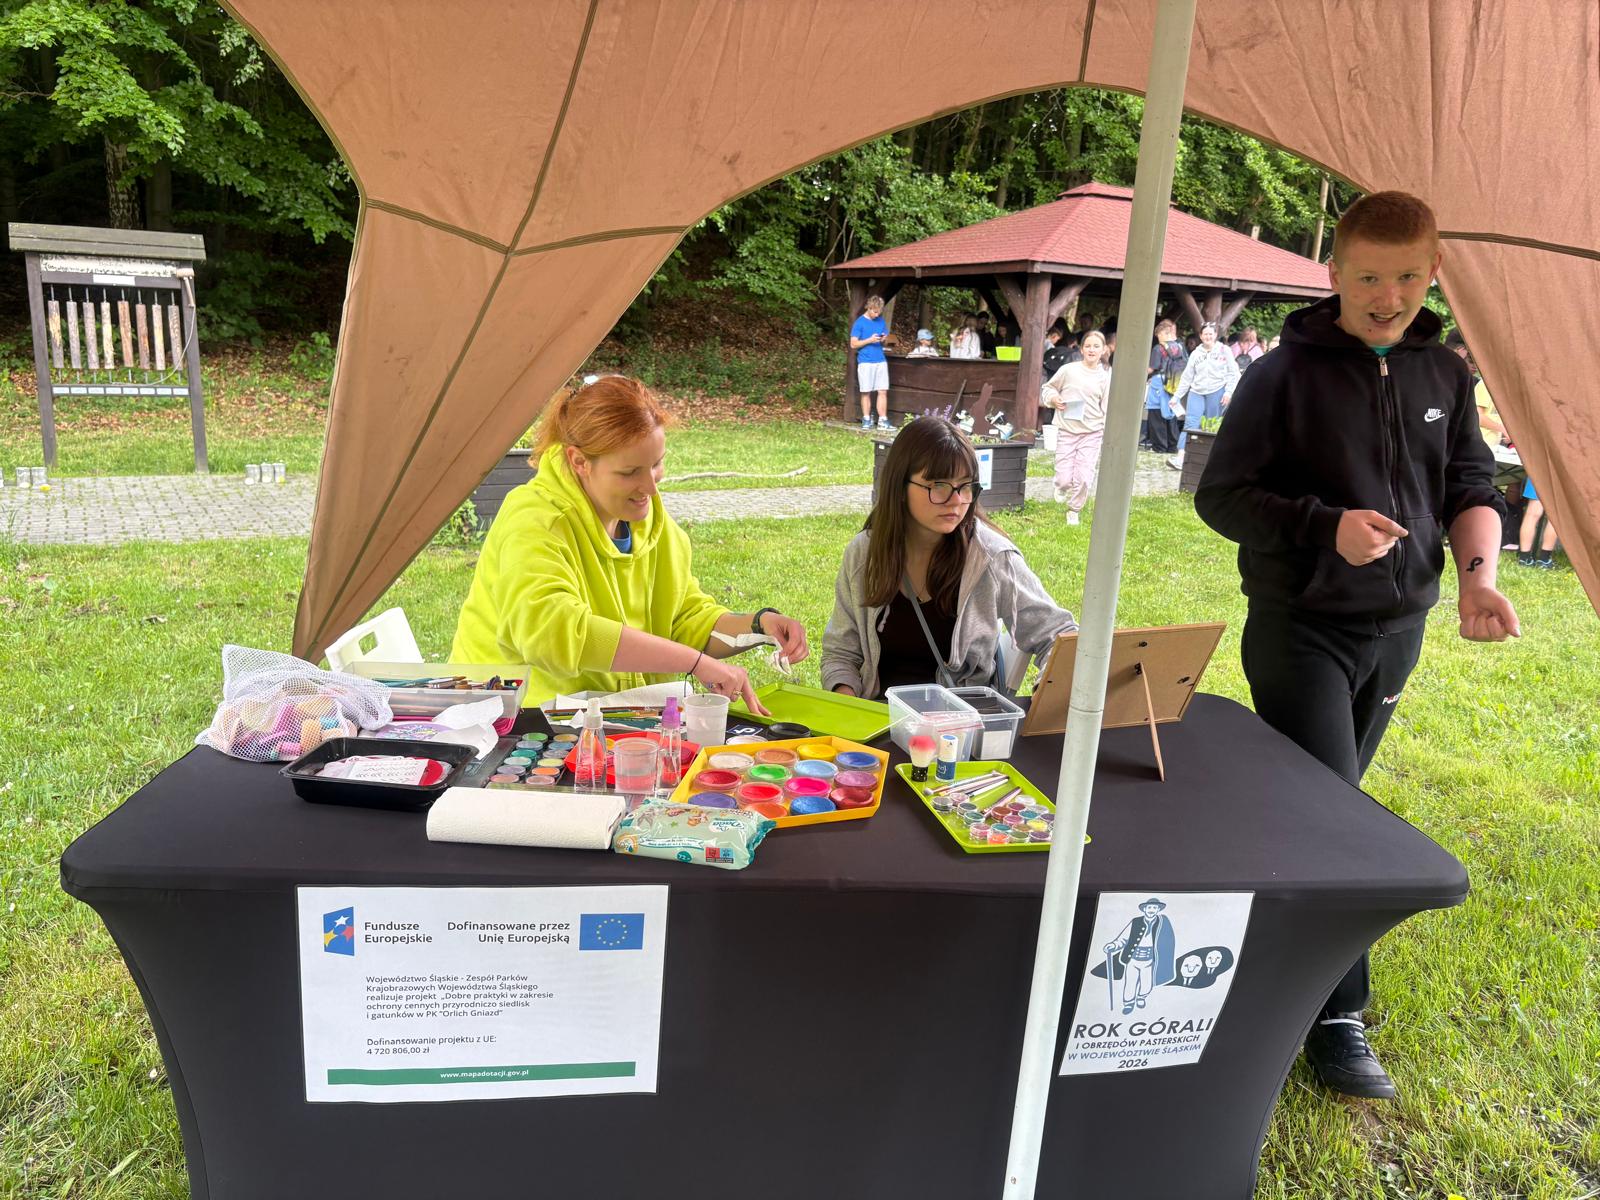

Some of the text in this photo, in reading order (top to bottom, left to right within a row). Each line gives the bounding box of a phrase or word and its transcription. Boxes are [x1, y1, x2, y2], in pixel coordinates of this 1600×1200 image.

[1427, 407, 1442, 418] NIKE
[364, 921, 420, 931] Fundusze
[447, 921, 571, 932] Dofinansowane przez
[364, 933, 433, 944] Europejskie
[478, 933, 570, 944] Unię Europejską
[365, 975, 428, 984] Województwo
[429, 973, 459, 983] Śląskie
[465, 974, 495, 983] Zespół
[366, 982, 539, 993] Krajobrazowych Województwa Śląskiego
[366, 993, 404, 1002] realizuje
[405, 993, 437, 1002] projekt
[440, 992, 472, 1000] „Dobre
[473, 991, 508, 1000] praktyki
[519, 991, 554, 999] zakresie
[366, 1000, 531, 1011] ochrony cennych przyrodniczo siedlisk
[371, 1011, 415, 1020] gatunków
[426, 1010, 438, 1018] PK
[1073, 1017, 1213, 1039] ROK GÓRALI
[367, 1037, 437, 1046] Dofinansowanie
[438, 1035, 474, 1045] projektu
[483, 1035, 497, 1043] UE:
[1075, 1034, 1200, 1050] I OBRZĘDÓW PASTERSKICH
[392, 1047, 421, 1055] 806,00
[422, 1046, 430, 1054] zł
[1080, 1049, 1160, 1060] WOJEWÓDZTWIE
[1161, 1043, 1201, 1055] ŚLĄSKIM
[1117, 1058, 1148, 1069] 2026
[440, 1069, 529, 1078] www.mapadotacji.gov.pl
